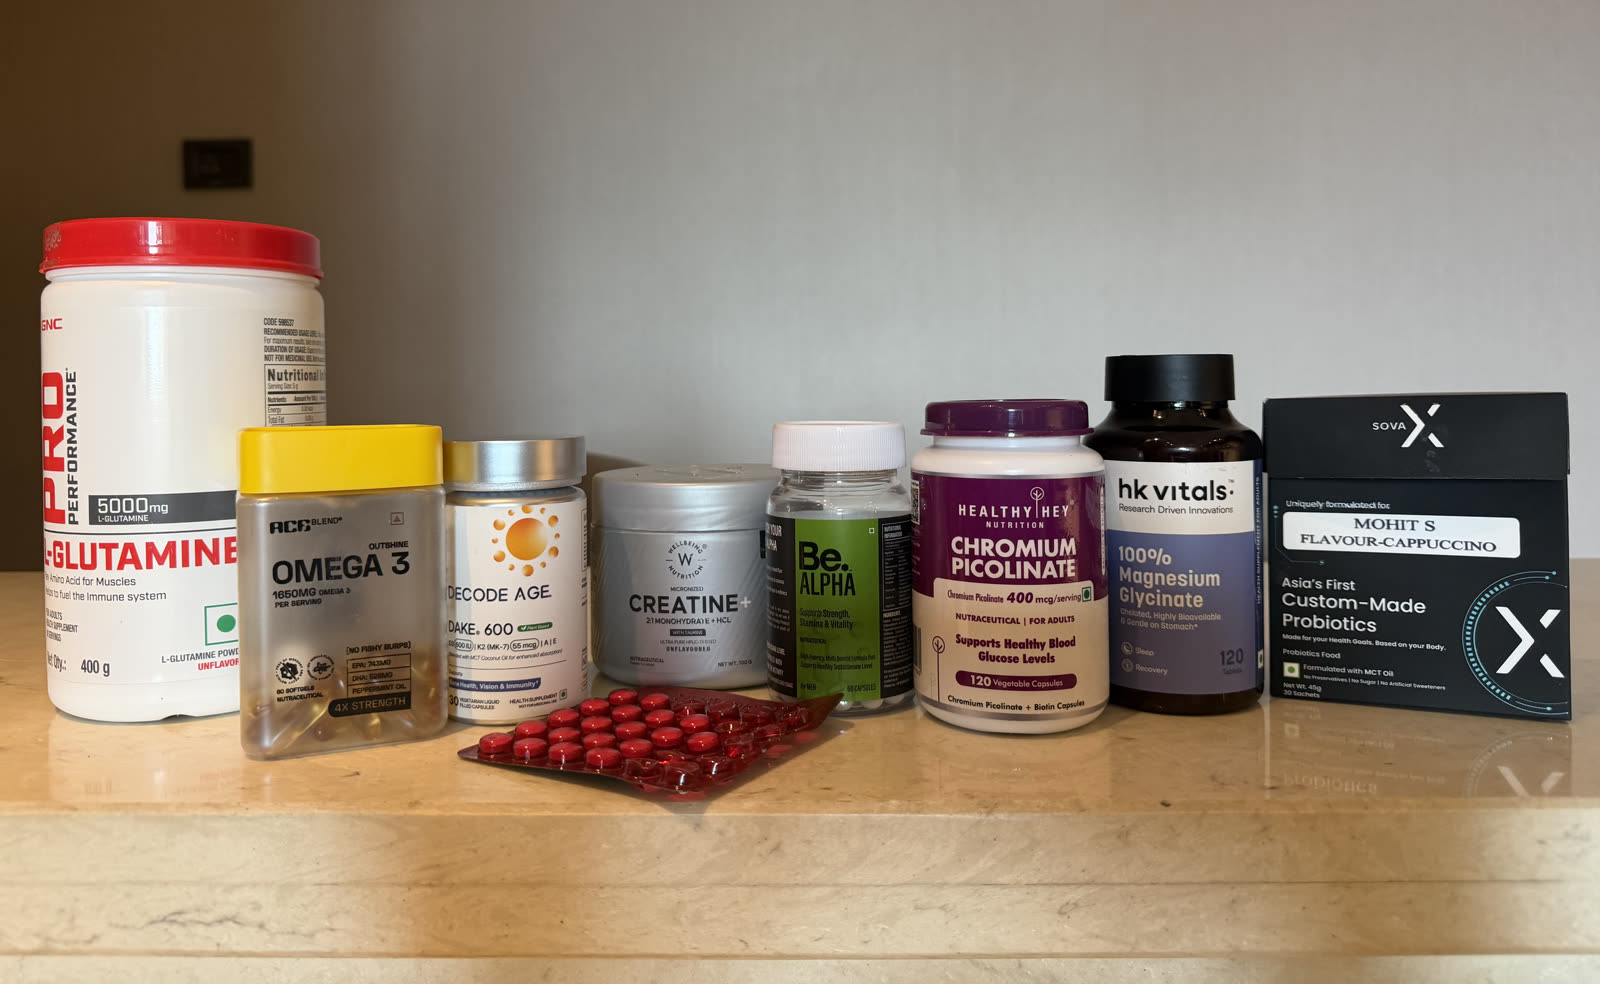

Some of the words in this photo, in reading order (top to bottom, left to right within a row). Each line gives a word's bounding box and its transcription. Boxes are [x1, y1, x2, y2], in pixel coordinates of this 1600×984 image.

[1372, 421, 1407, 431] SOVA
[1400, 403, 1445, 448] X
[42, 372, 66, 525] PRO
[65, 371, 79, 526] PERFORMANCE
[1118, 477, 1149, 500] hk
[98, 497, 148, 514] 5000
[149, 503, 169, 515] mg
[959, 504, 1032, 518] HEALTHY
[1041, 505, 1069, 518] HEY
[1118, 503, 1155, 514] Research
[1158, 505, 1186, 515] Driven
[1189, 506, 1234, 515] Innovations
[1285, 500, 1325, 510] Uniquely
[1325, 501, 1377, 509] formulated
[98, 515, 149, 523] L-GLUTAMINE
[986, 521, 1045, 529] NUTRITION
[1353, 518, 1418, 532] MOHIT
[1424, 519, 1436, 532] S
[368, 541, 409, 550] OUTSHINE
[668, 540, 703, 554] WELLBEING
[951, 536, 1077, 557] CHROMIUM
[1299, 533, 1497, 553] FLAVOUR-CAPPUCCINO
[44, 536, 237, 571] L-GLUTAMINE
[798, 541, 849, 572] Be.
[1118, 546, 1172, 566] 100%
[272, 553, 384, 585] OMEGA
[391, 551, 410, 575] 3
[668, 565, 704, 580] NUTRITION
[951, 557, 1076, 579] PICOLINATE
[66, 576, 81, 586] Acid
[82, 577, 94, 586] for
[96, 577, 136, 587] Muscles
[800, 572, 856, 596] ALPHA
[1119, 566, 1221, 589] Magnesium
[1281, 577, 1323, 590] Asia's
[1326, 578, 1356, 591] First
[60, 589, 71, 600] fuel
[73, 592, 85, 601] the
[87, 592, 125, 602] Immune
[127, 592, 167, 604] system
[272, 587, 316, 600] 1650MG
[448, 585, 508, 602] DECODE
[947, 589, 974, 601] Chromium
[975, 593, 1004, 603] Picolinate
[1006, 591, 1034, 604] 400
[1035, 592, 1082, 606] mcg/serving
[1120, 587, 1204, 608] Glycinate
[274, 601, 289, 609] PER
[291, 598, 322, 607] SERVING
[1281, 592, 1427, 614] Custom-Made
[655, 617, 710, 625] MONOHYDRATE
[716, 616, 731, 624] HCL
[822, 608, 851, 620] Strength,
[955, 612, 1021, 625] NUTRACEUTICAL
[1029, 617, 1046, 625] FOR
[1047, 615, 1075, 624] ADULTS
[1120, 608, 1151, 619] Chelated,
[1153, 611, 1177, 622] Highly
[1178, 613, 1221, 621] Bioavailable
[484, 623, 513, 636] 600
[800, 620, 823, 629] Stamina
[831, 620, 853, 630] Vitality
[1127, 619, 1149, 628] Gentle
[1282, 612, 1377, 633] Probiotics
[487, 643, 509, 651] (MK-7)
[523, 642, 537, 650] mcg
[955, 634, 1001, 649] Supports
[1004, 638, 1046, 651] Healthy
[1049, 636, 1076, 649] Blood
[1282, 633, 1301, 641] Made
[1328, 636, 1351, 644] Health
[1352, 638, 1374, 646] Goals.
[1408, 643, 1425, 651] your
[1426, 643, 1446, 652] Body.
[161, 651, 216, 664] L-GLUTAMINE
[978, 651, 1020, 664] Glucose
[1022, 652, 1056, 664] Levels
[1135, 647, 1155, 657] Sleep
[1220, 648, 1244, 666] 120
[1282, 648, 1320, 658] Probiotics
[1321, 651, 1341, 659] Food
[81, 659, 100, 674] 400
[103, 663, 110, 677] g
[1135, 664, 1168, 676] Recovery
[1303, 664, 1346, 674] Formulated
[1346, 667, 1363, 675] with
[1364, 669, 1382, 677] MCT
[1382, 669, 1394, 677] Oil
[854, 684, 876, 692] CAPSULES
[970, 674, 992, 687] 120
[992, 678, 1030, 689] Vegetable
[1032, 679, 1063, 689] Capsules
[1308, 684, 1322, 693] 45g
[1312, 674, 1347, 683] Preservatives
[1389, 680, 1412, 688] Artificial
[1413, 682, 1446, 690] Sweeteners
[449, 695, 459, 706] 30
[1293, 690, 1320, 699] Sachets
[334, 702, 349, 713] 4X
[351, 697, 406, 711] STRENGTH
[947, 694, 984, 708] Chromium
[985, 701, 1023, 711] Picolinate
[1034, 703, 1055, 711] Biotin
[1056, 699, 1086, 711] Capsules
